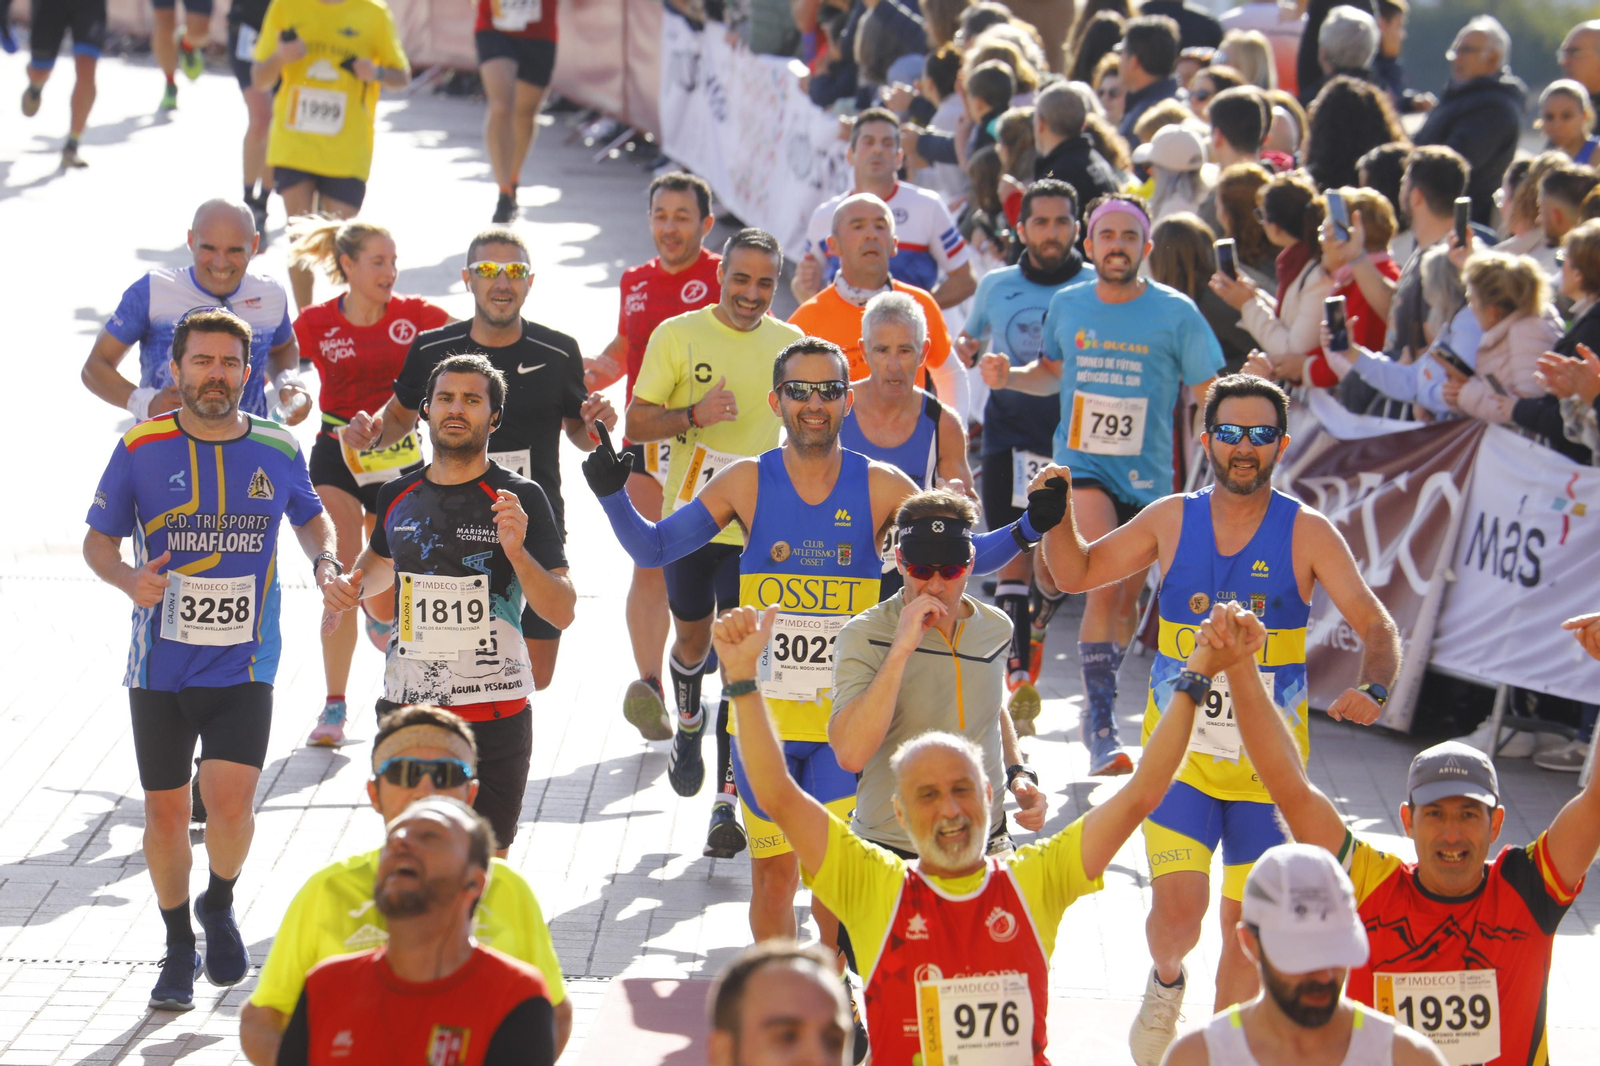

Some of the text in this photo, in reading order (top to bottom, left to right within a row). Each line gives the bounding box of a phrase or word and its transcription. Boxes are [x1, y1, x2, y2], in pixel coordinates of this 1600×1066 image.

[301, 99, 341, 122] 1999
[1076, 355, 1143, 373] TORNEO DE FÚTBOL
[1076, 369, 1141, 387] MÉDICOS DEL SUR
[1091, 412, 1133, 437] 793
[165, 514, 270, 530] C.D. TRI SPORTS
[167, 532, 265, 553] MIRAFLORES
[803, 540, 824, 548] CLUB
[791, 549, 836, 558] ATLETISMO
[800, 558, 825, 567] OSSET
[192, 582, 229, 591] IMDECO
[422, 582, 457, 591] IMDECO
[758, 577, 862, 612] OSSET
[1216, 591, 1237, 599] CLUB
[167, 599, 176, 625] CAJÓN
[180, 595, 250, 624] 3258
[416, 598, 484, 624] 1819
[785, 619, 821, 629] IMDECO
[451, 685, 481, 694] ÁGUILA
[751, 834, 787, 849] OSSET
[1151, 848, 1192, 866] OSSET
[954, 982, 1000, 994] IMDECO
[1409, 976, 1456, 986] IMDECO
[954, 1001, 1019, 1039] 976
[1398, 994, 1491, 1031] 1939
